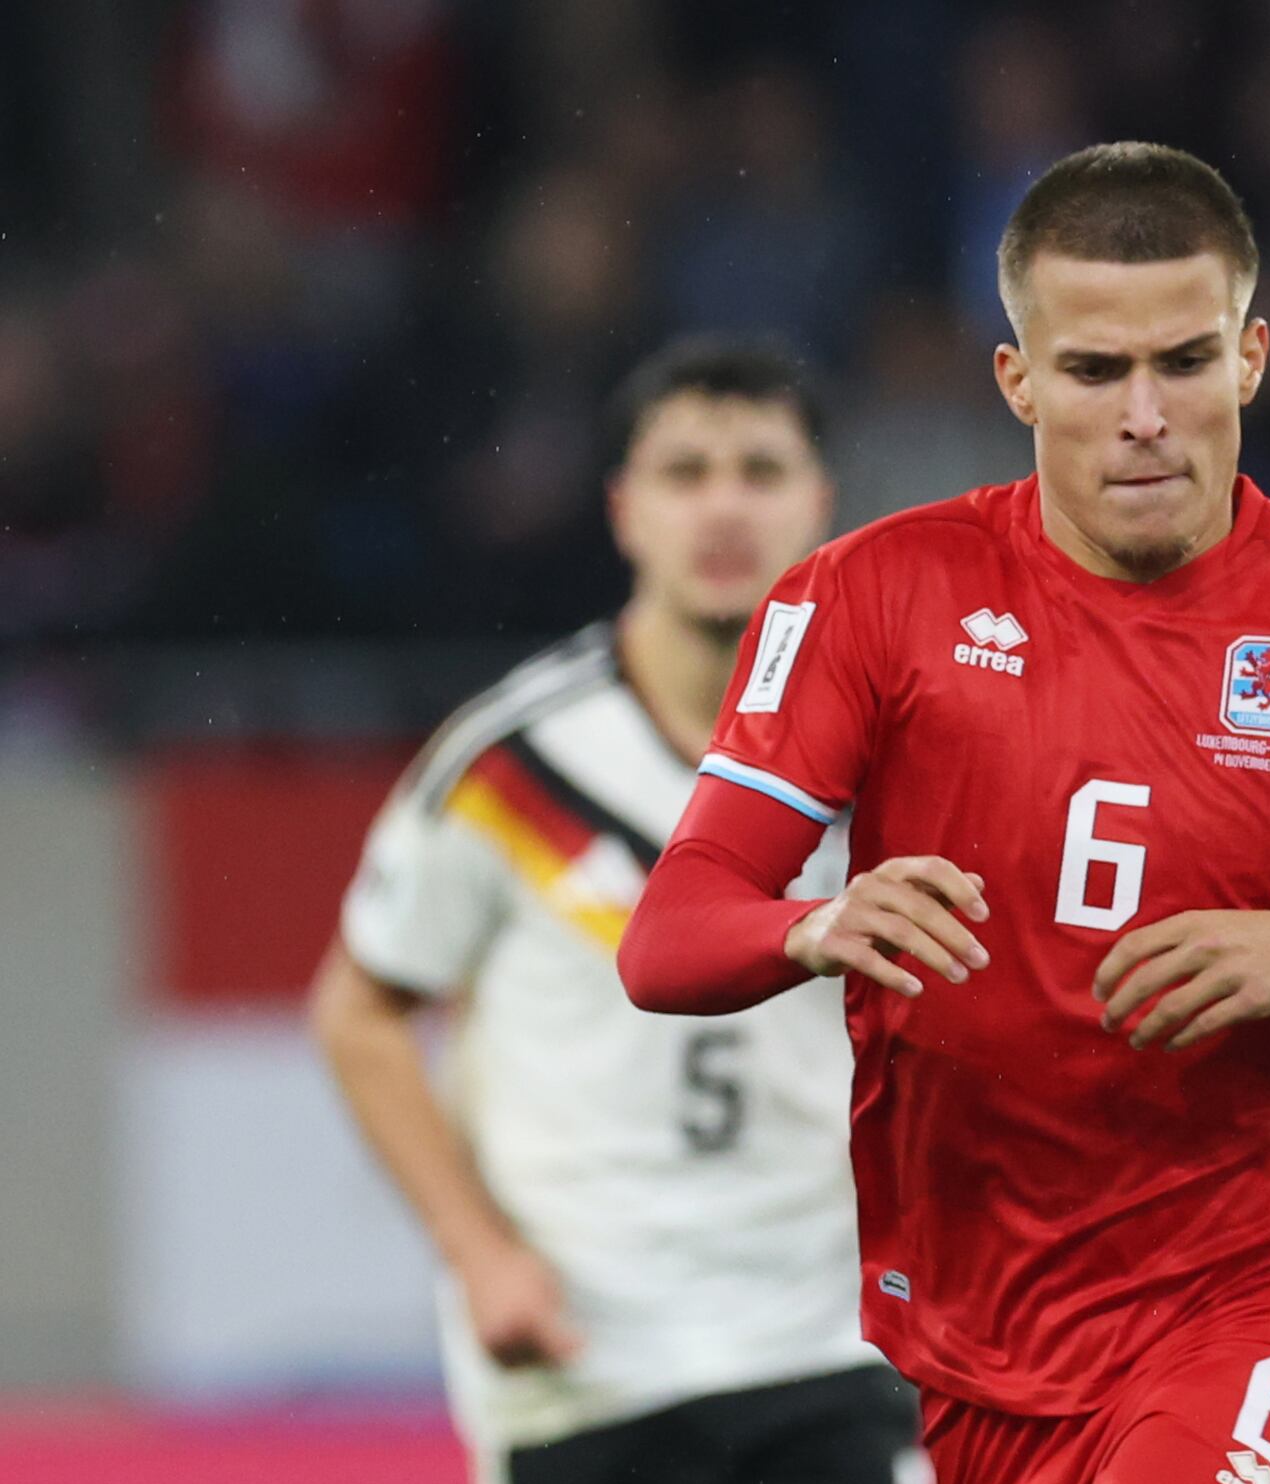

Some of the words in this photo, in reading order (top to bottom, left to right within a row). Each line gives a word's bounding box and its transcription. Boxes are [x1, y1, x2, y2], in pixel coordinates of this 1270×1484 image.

[953, 643, 1025, 677] errea
[1054, 779, 1151, 932] 6
[681, 1028, 744, 1152] 5
